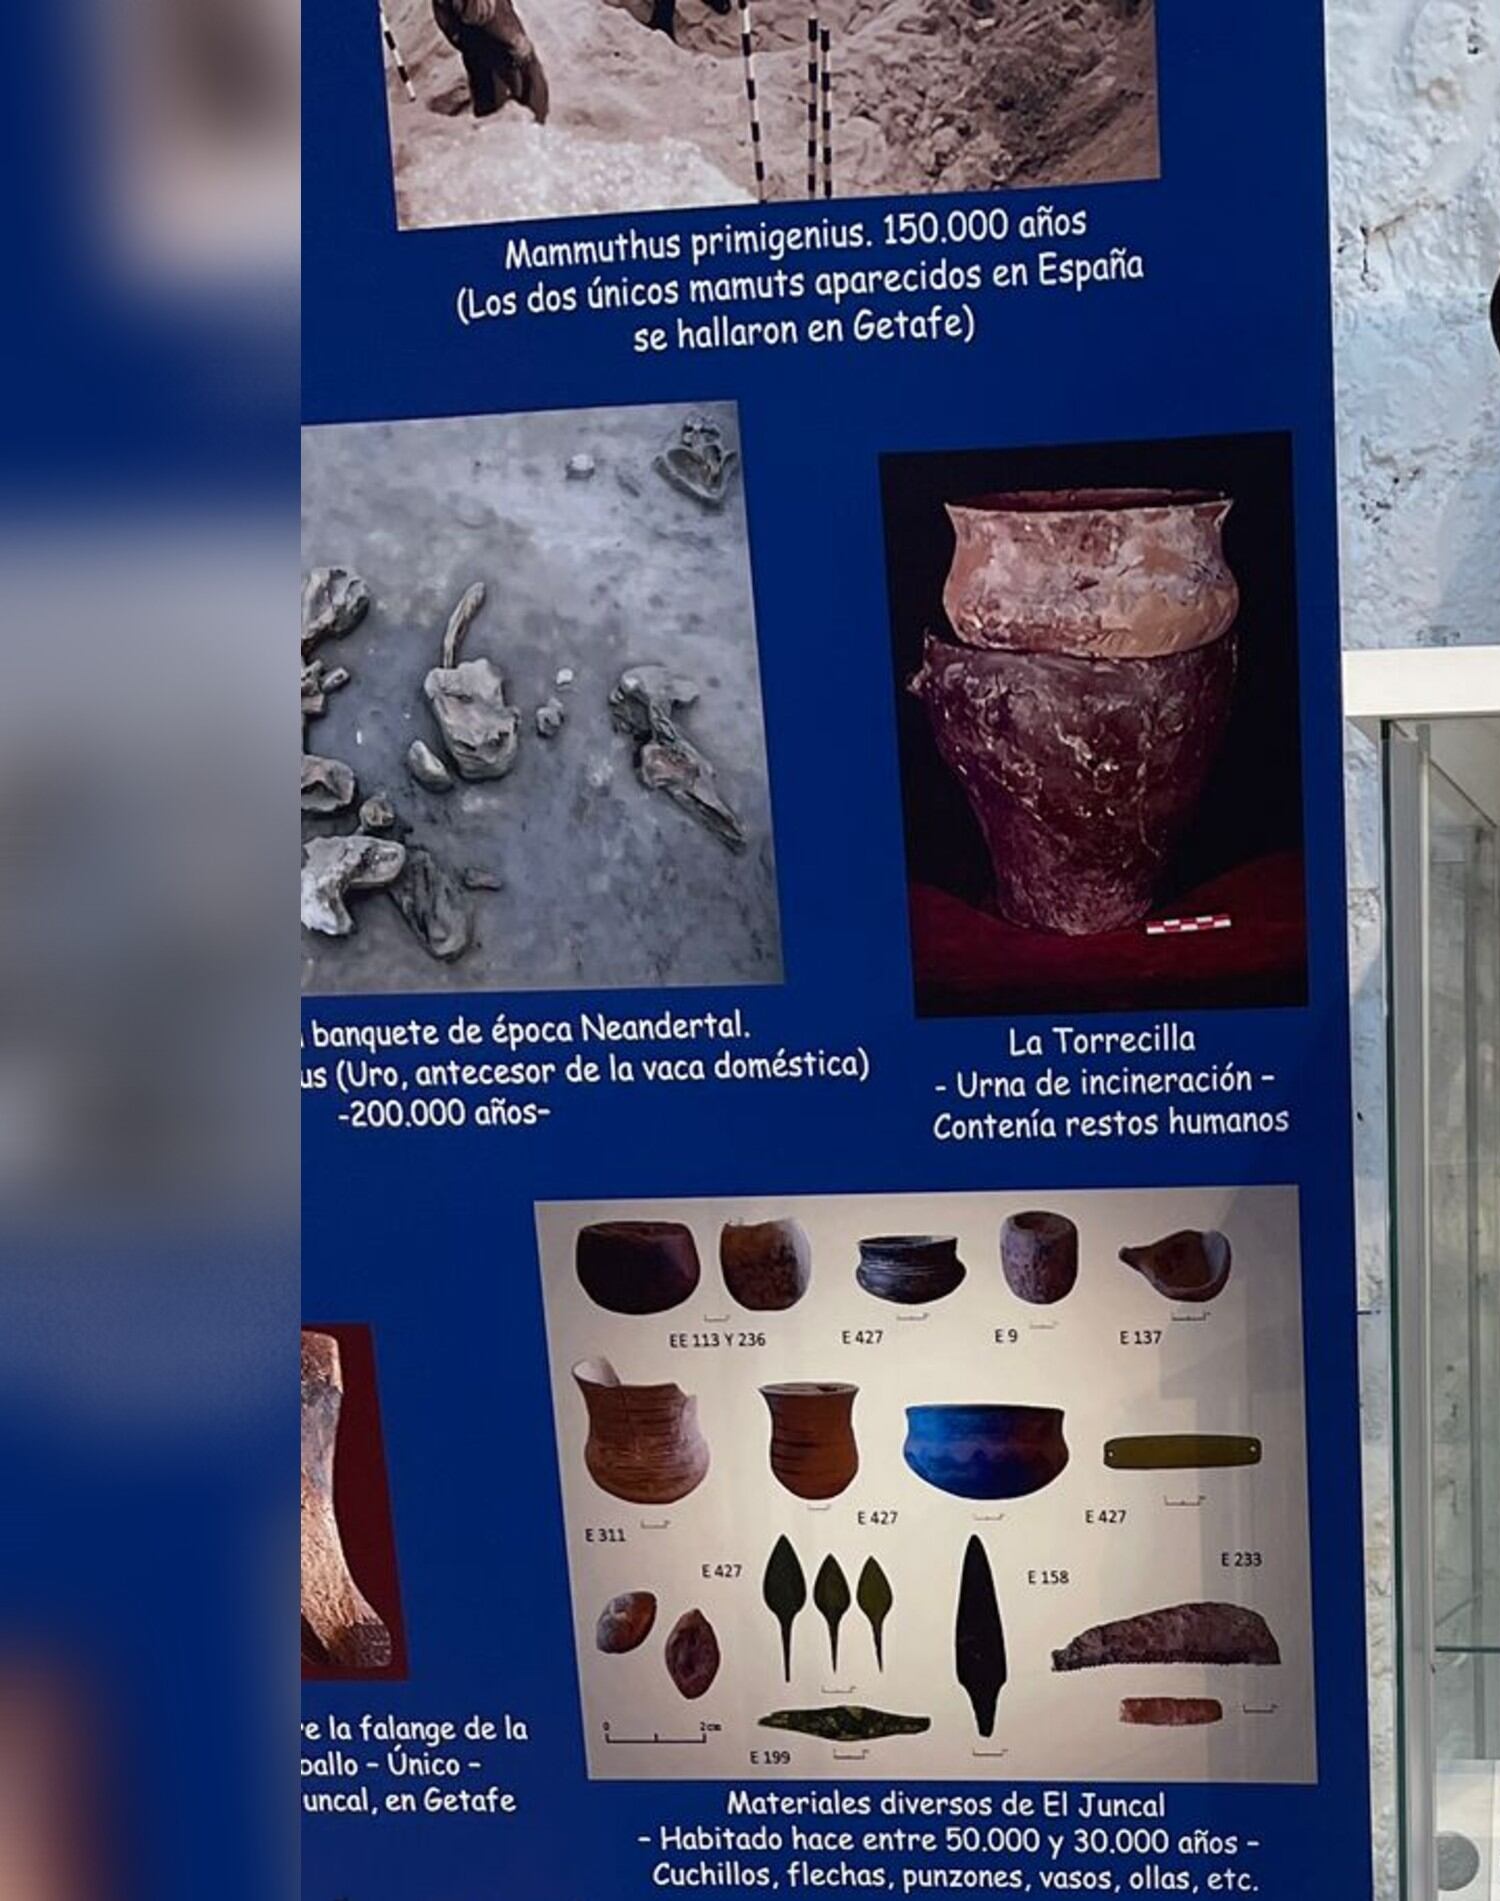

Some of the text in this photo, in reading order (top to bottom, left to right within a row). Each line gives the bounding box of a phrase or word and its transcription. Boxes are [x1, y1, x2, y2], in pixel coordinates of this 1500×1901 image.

[506, 206, 1086, 269] Mammuthus primigenius. 150.000 años
[457, 248, 1143, 325] (Los dos únicos mamuts aparecidos en España
[634, 304, 974, 351] se hallaron en Getafe)
[312, 1020, 439, 1053] banquete
[448, 1016, 482, 1044] de
[492, 1014, 573, 1051] época
[581, 1009, 750, 1041] Neandertal.
[1010, 1023, 1195, 1056] La Torrecilla
[337, 1060, 407, 1093] (Uro,
[416, 1061, 555, 1086] antecesor
[566, 1054, 600, 1082] de
[610, 1054, 634, 1081] la
[642, 1060, 705, 1080] vaca
[715, 1047, 869, 1081] doméstica)
[958, 1062, 1252, 1098] Urna de incineración
[339, 1098, 550, 1127] -200.000 años-
[934, 1106, 1288, 1139] Contenía restos humanos
[670, 1333, 766, 1348] EE 113 Y 236
[842, 1329, 883, 1344] E 427
[995, 1329, 1018, 1344] E 9
[1120, 1330, 1162, 1345] E 137
[857, 1510, 898, 1525] E 427
[1085, 1510, 1127, 1524] E 427
[585, 1528, 626, 1542] E 311
[702, 1564, 742, 1578] E 427
[1222, 1552, 1262, 1567] E 233
[1028, 1570, 1069, 1585] E 158
[329, 1715, 352, 1739] la
[359, 1715, 456, 1747] falange
[465, 1715, 496, 1739] de
[505, 1715, 528, 1739] la
[603, 1721, 610, 1731] 0
[388, 1744, 459, 1775] Único
[750, 1751, 790, 1764] E 199
[386, 1794, 416, 1811] en
[424, 1787, 516, 1812] Getafe
[728, 1790, 1164, 1817] Materiales diversos de El Juncal
[661, 1826, 1237, 1859] Habitado hace entre 50.000 y 30.000 años
[653, 1861, 1258, 1893] Cuchillos, flechas, punzones, vasos, ollas, etc.
